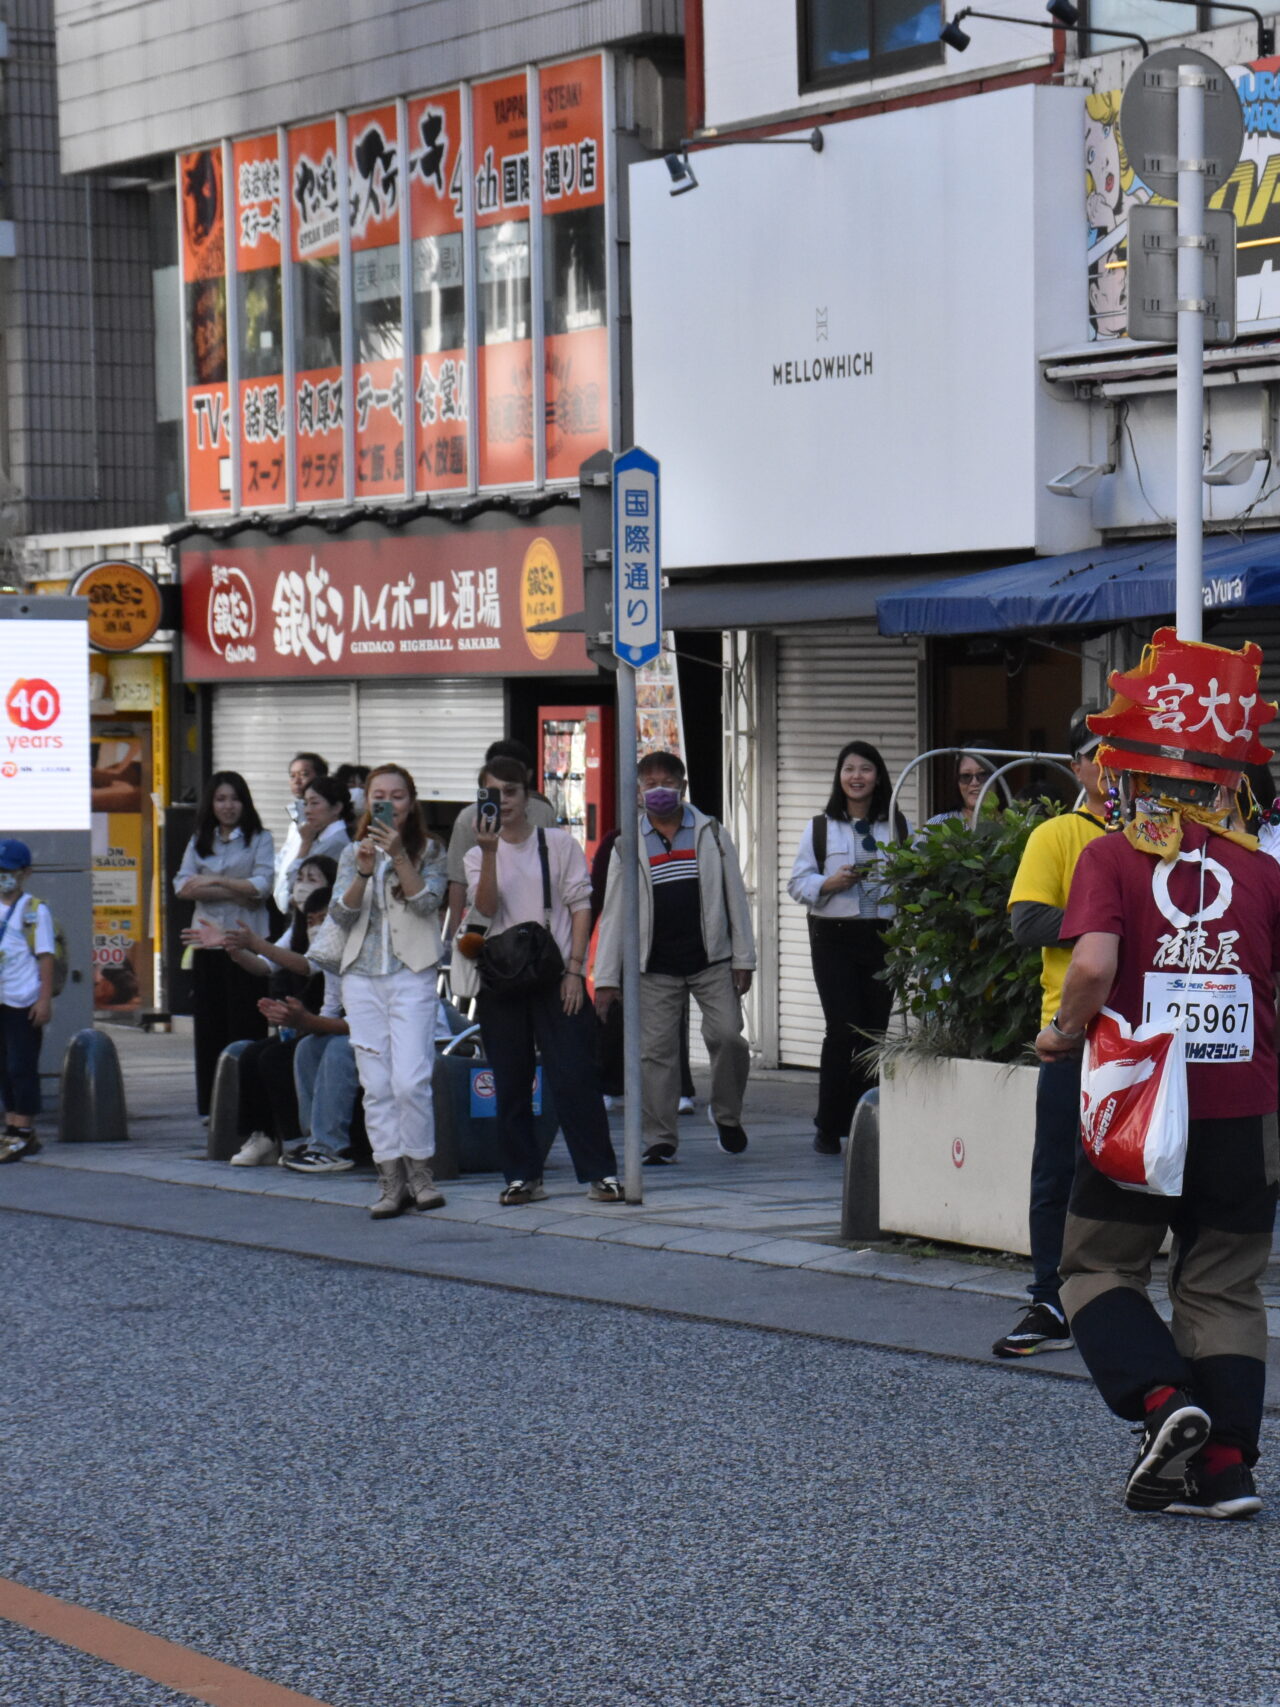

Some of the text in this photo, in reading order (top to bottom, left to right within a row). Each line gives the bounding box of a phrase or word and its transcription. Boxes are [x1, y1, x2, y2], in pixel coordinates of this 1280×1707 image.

[323, 219, 340, 238] HOUS
[773, 351, 872, 386] MELLOWHICH
[624, 489, 650, 627] 国際通り
[271, 554, 344, 665] 銀だこ
[351, 566, 501, 632] ハイボール酒場
[351, 637, 501, 654] GINDACO HIGHBALL SAKABA
[10, 688, 55, 722] 40
[1148, 673, 1257, 742] 宮大工
[6, 735, 63, 753] years
[1203, 981, 1237, 990] SPORTS
